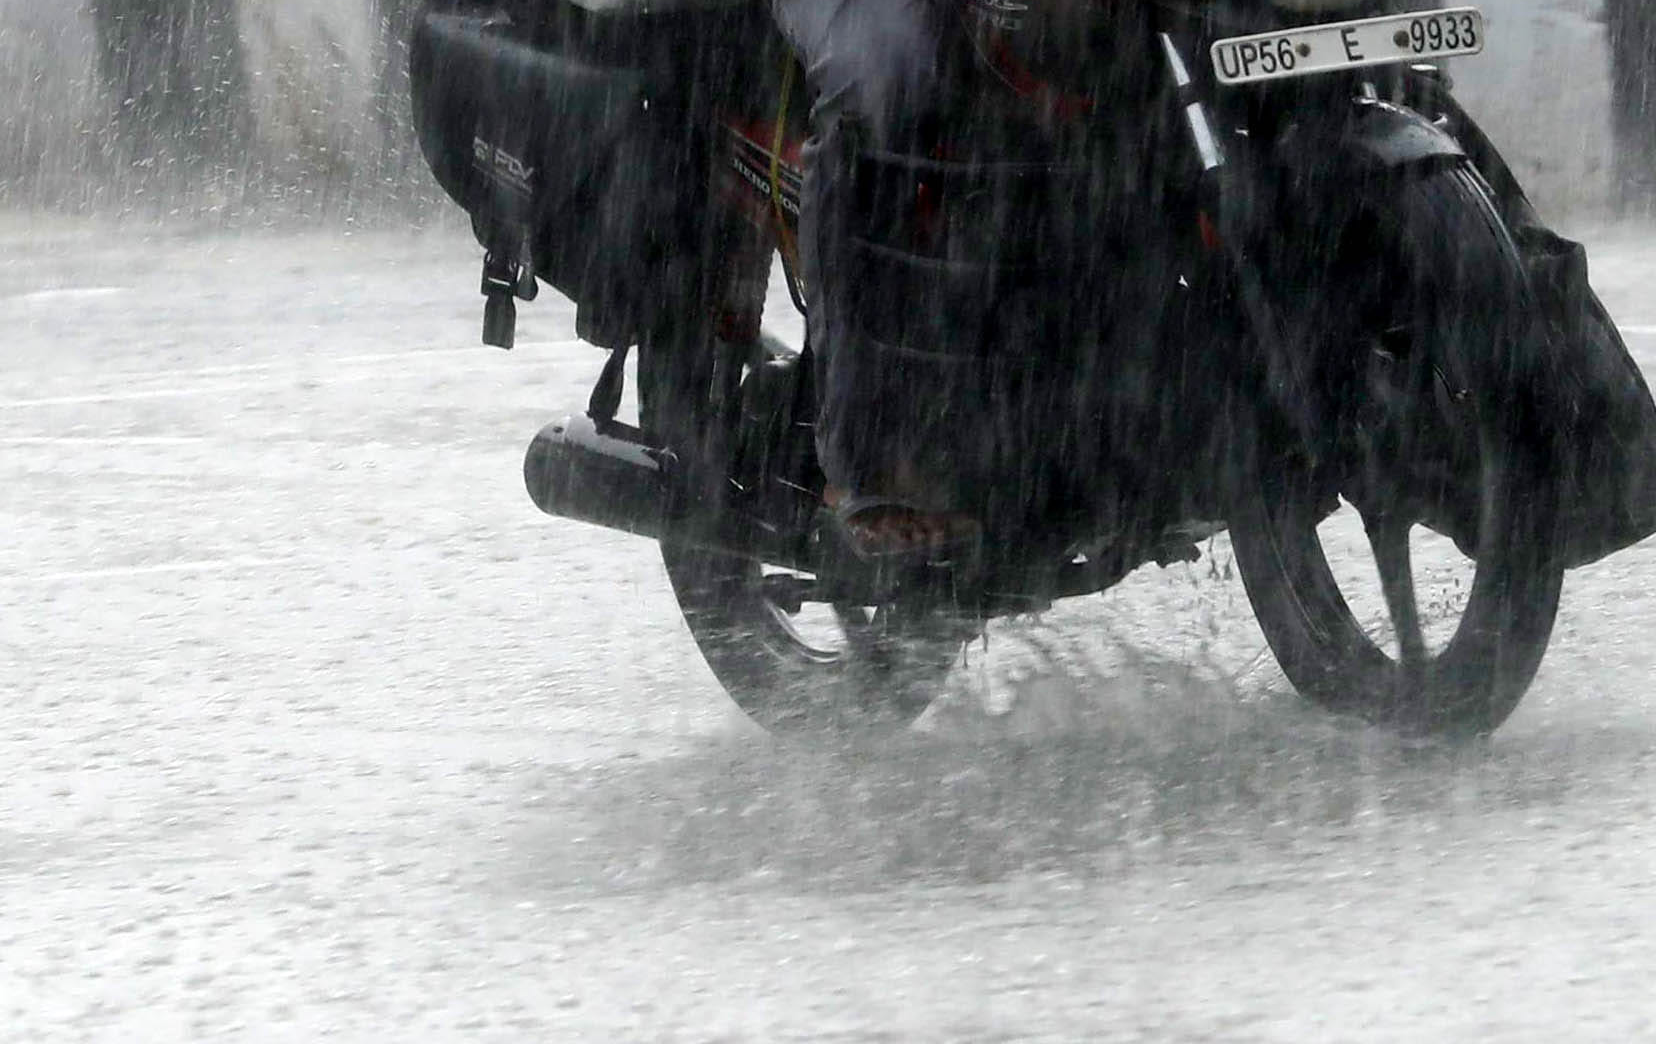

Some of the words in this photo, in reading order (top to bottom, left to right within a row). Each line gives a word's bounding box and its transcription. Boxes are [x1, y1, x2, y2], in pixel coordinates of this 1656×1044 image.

[1217, 38, 1296, 79] UP56
[1341, 28, 1365, 62] E
[1409, 15, 1477, 54] 9933
